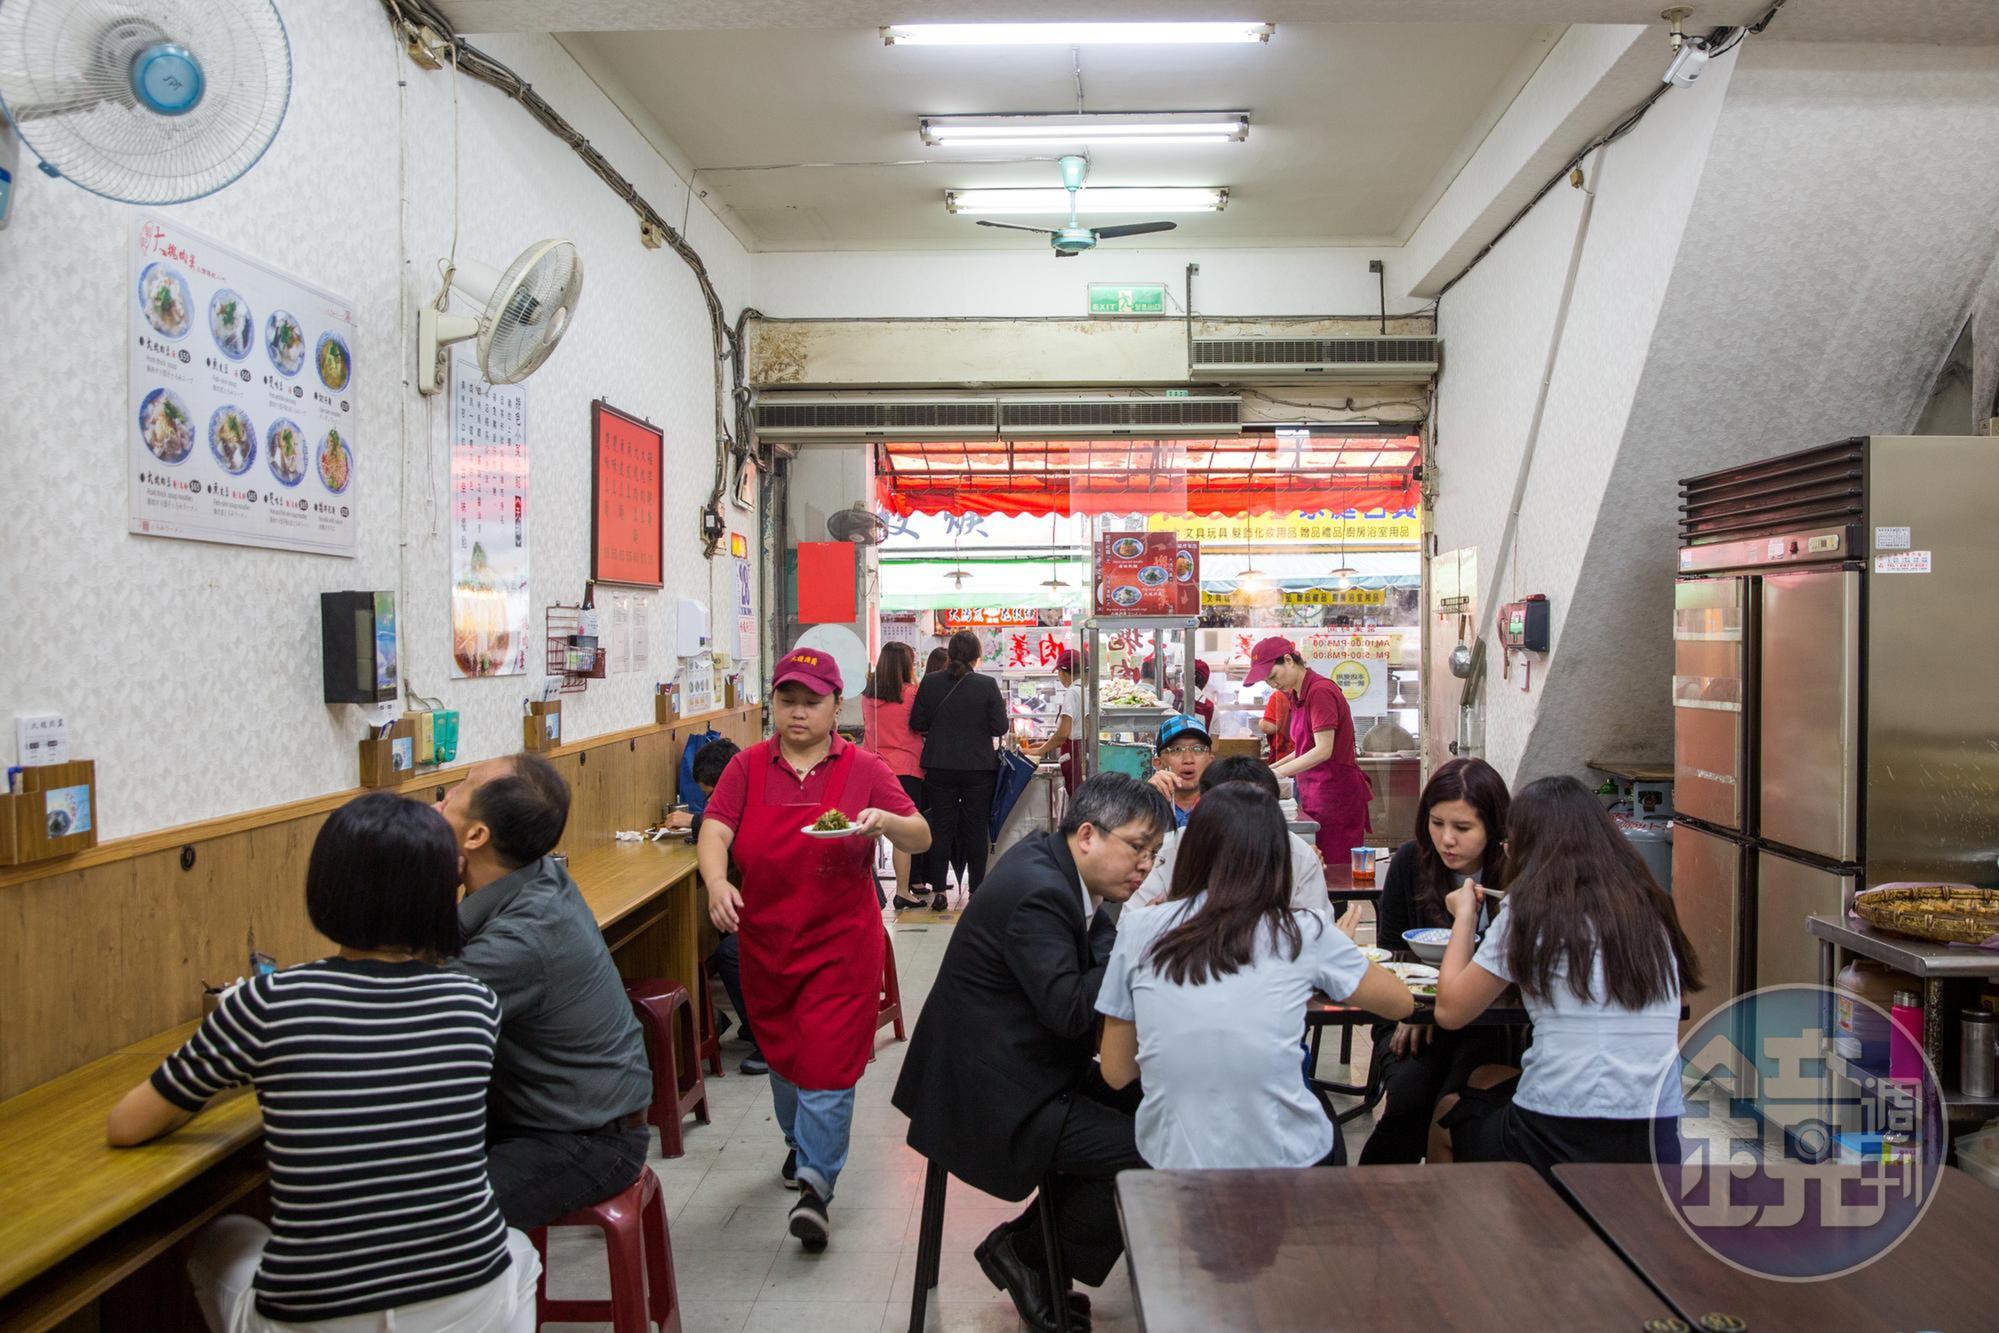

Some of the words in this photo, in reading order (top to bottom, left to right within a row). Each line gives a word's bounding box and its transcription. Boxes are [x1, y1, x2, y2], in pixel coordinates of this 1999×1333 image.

[1092, 303, 1116, 311] EXIT
[1186, 527, 1228, 539] 文具玩具
[1300, 526, 1343, 538] 贈品禮品
[1346, 526, 1410, 538] 廚房浴室用品
